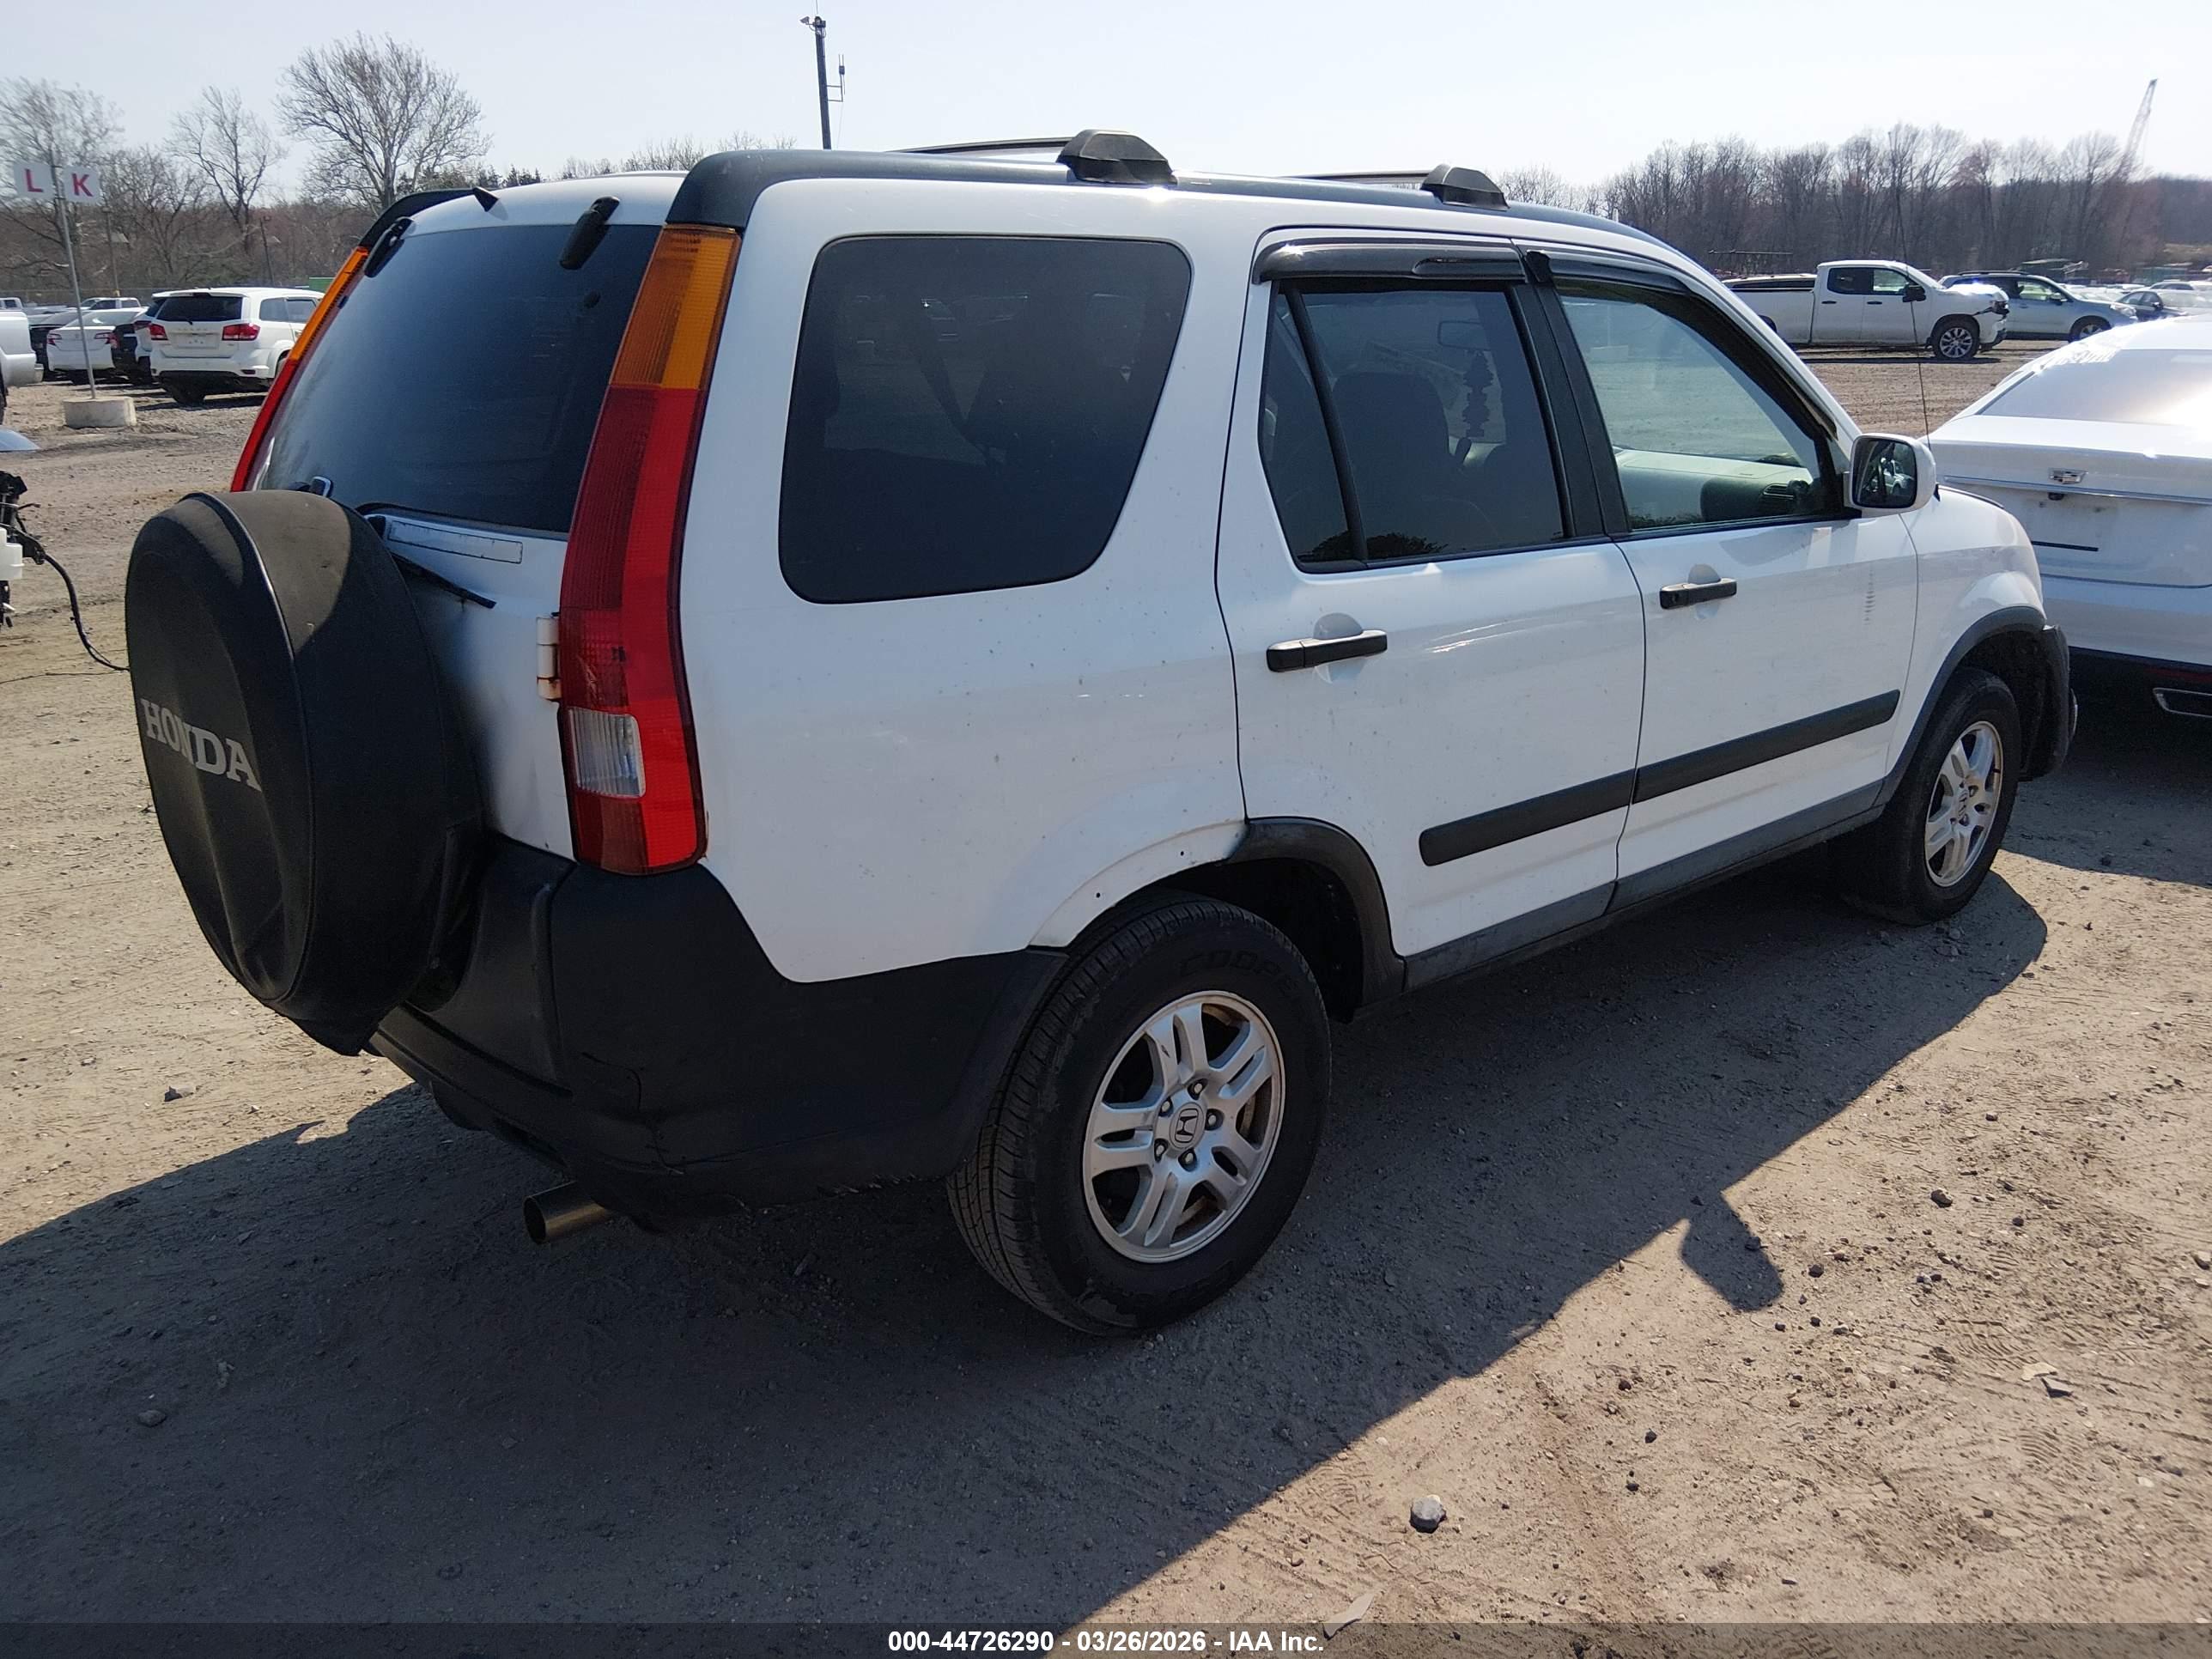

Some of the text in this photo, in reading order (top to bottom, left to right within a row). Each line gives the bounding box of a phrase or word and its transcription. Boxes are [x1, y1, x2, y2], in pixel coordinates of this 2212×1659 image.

[25, 169, 94, 197] L K
[140, 697, 263, 793] HONDA
